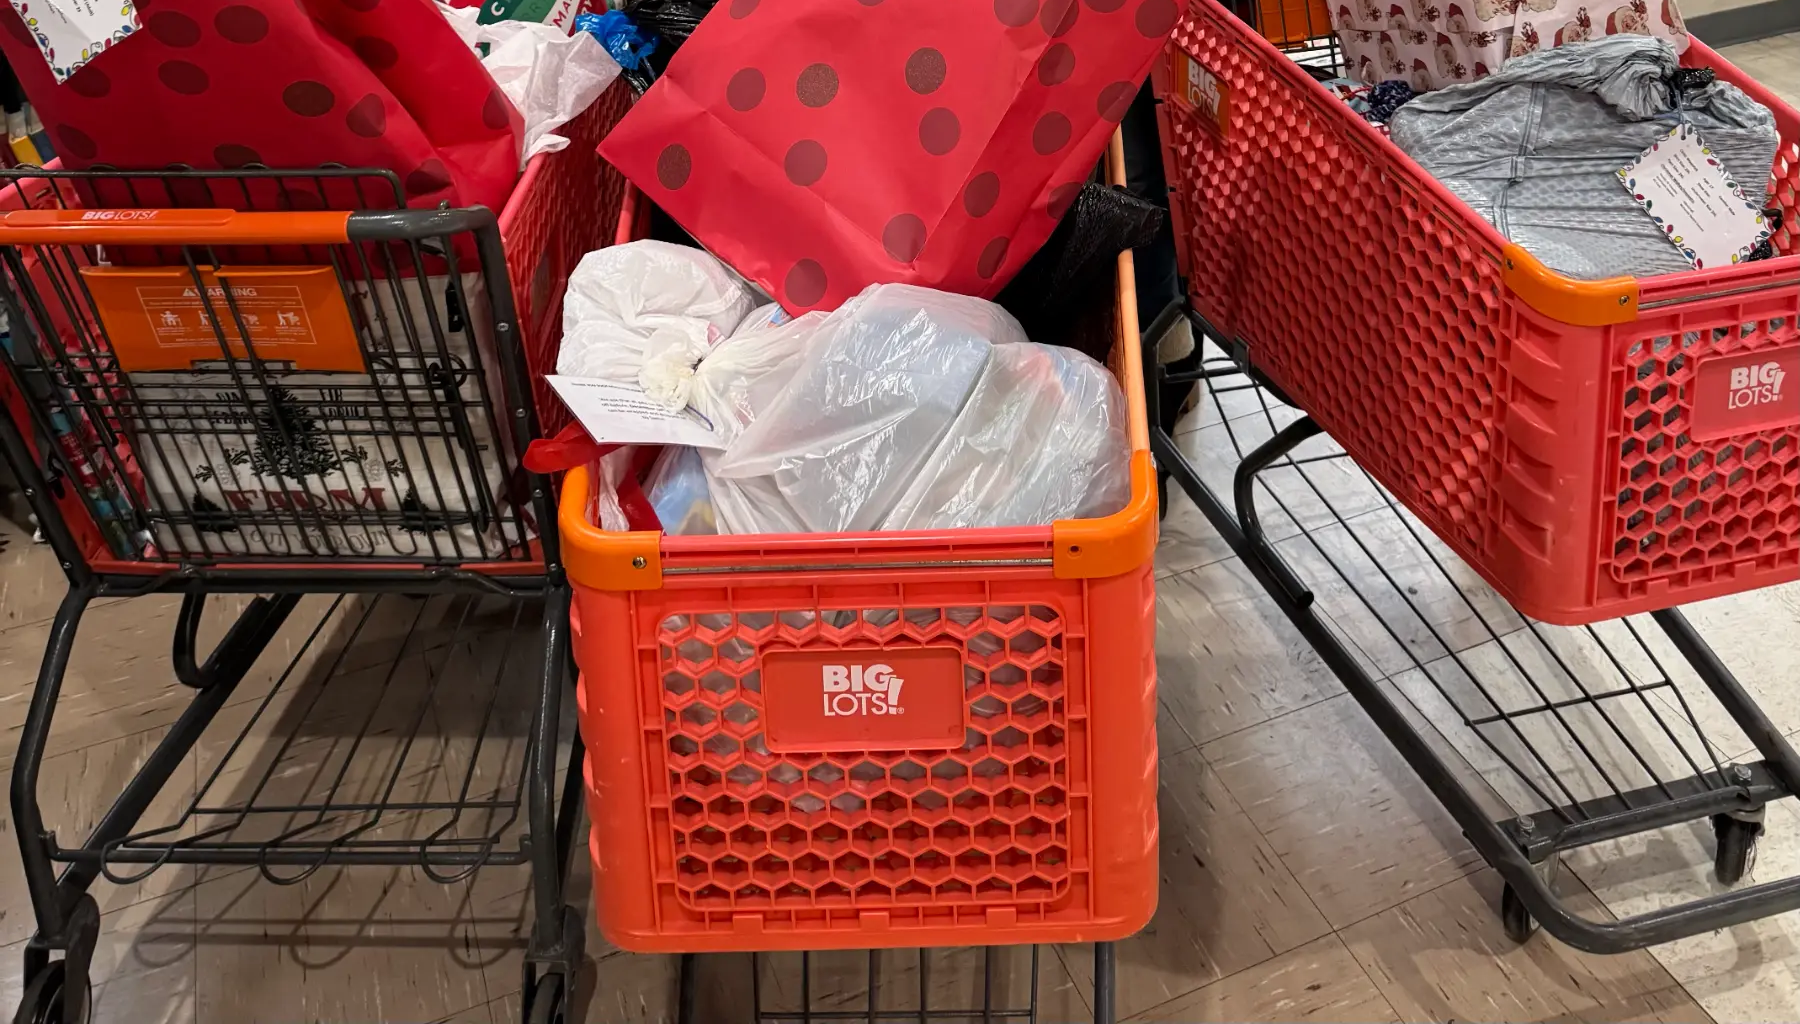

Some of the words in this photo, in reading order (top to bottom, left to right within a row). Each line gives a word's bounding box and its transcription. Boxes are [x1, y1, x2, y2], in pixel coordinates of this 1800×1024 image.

[1188, 57, 1217, 99] BIG
[81, 210, 115, 221] BIG
[195, 287, 258, 297] ARING
[1730, 361, 1782, 390] BIG
[1728, 371, 1786, 410] LOTS!
[822, 663, 897, 692] BIG
[823, 678, 904, 716] LOTS!
